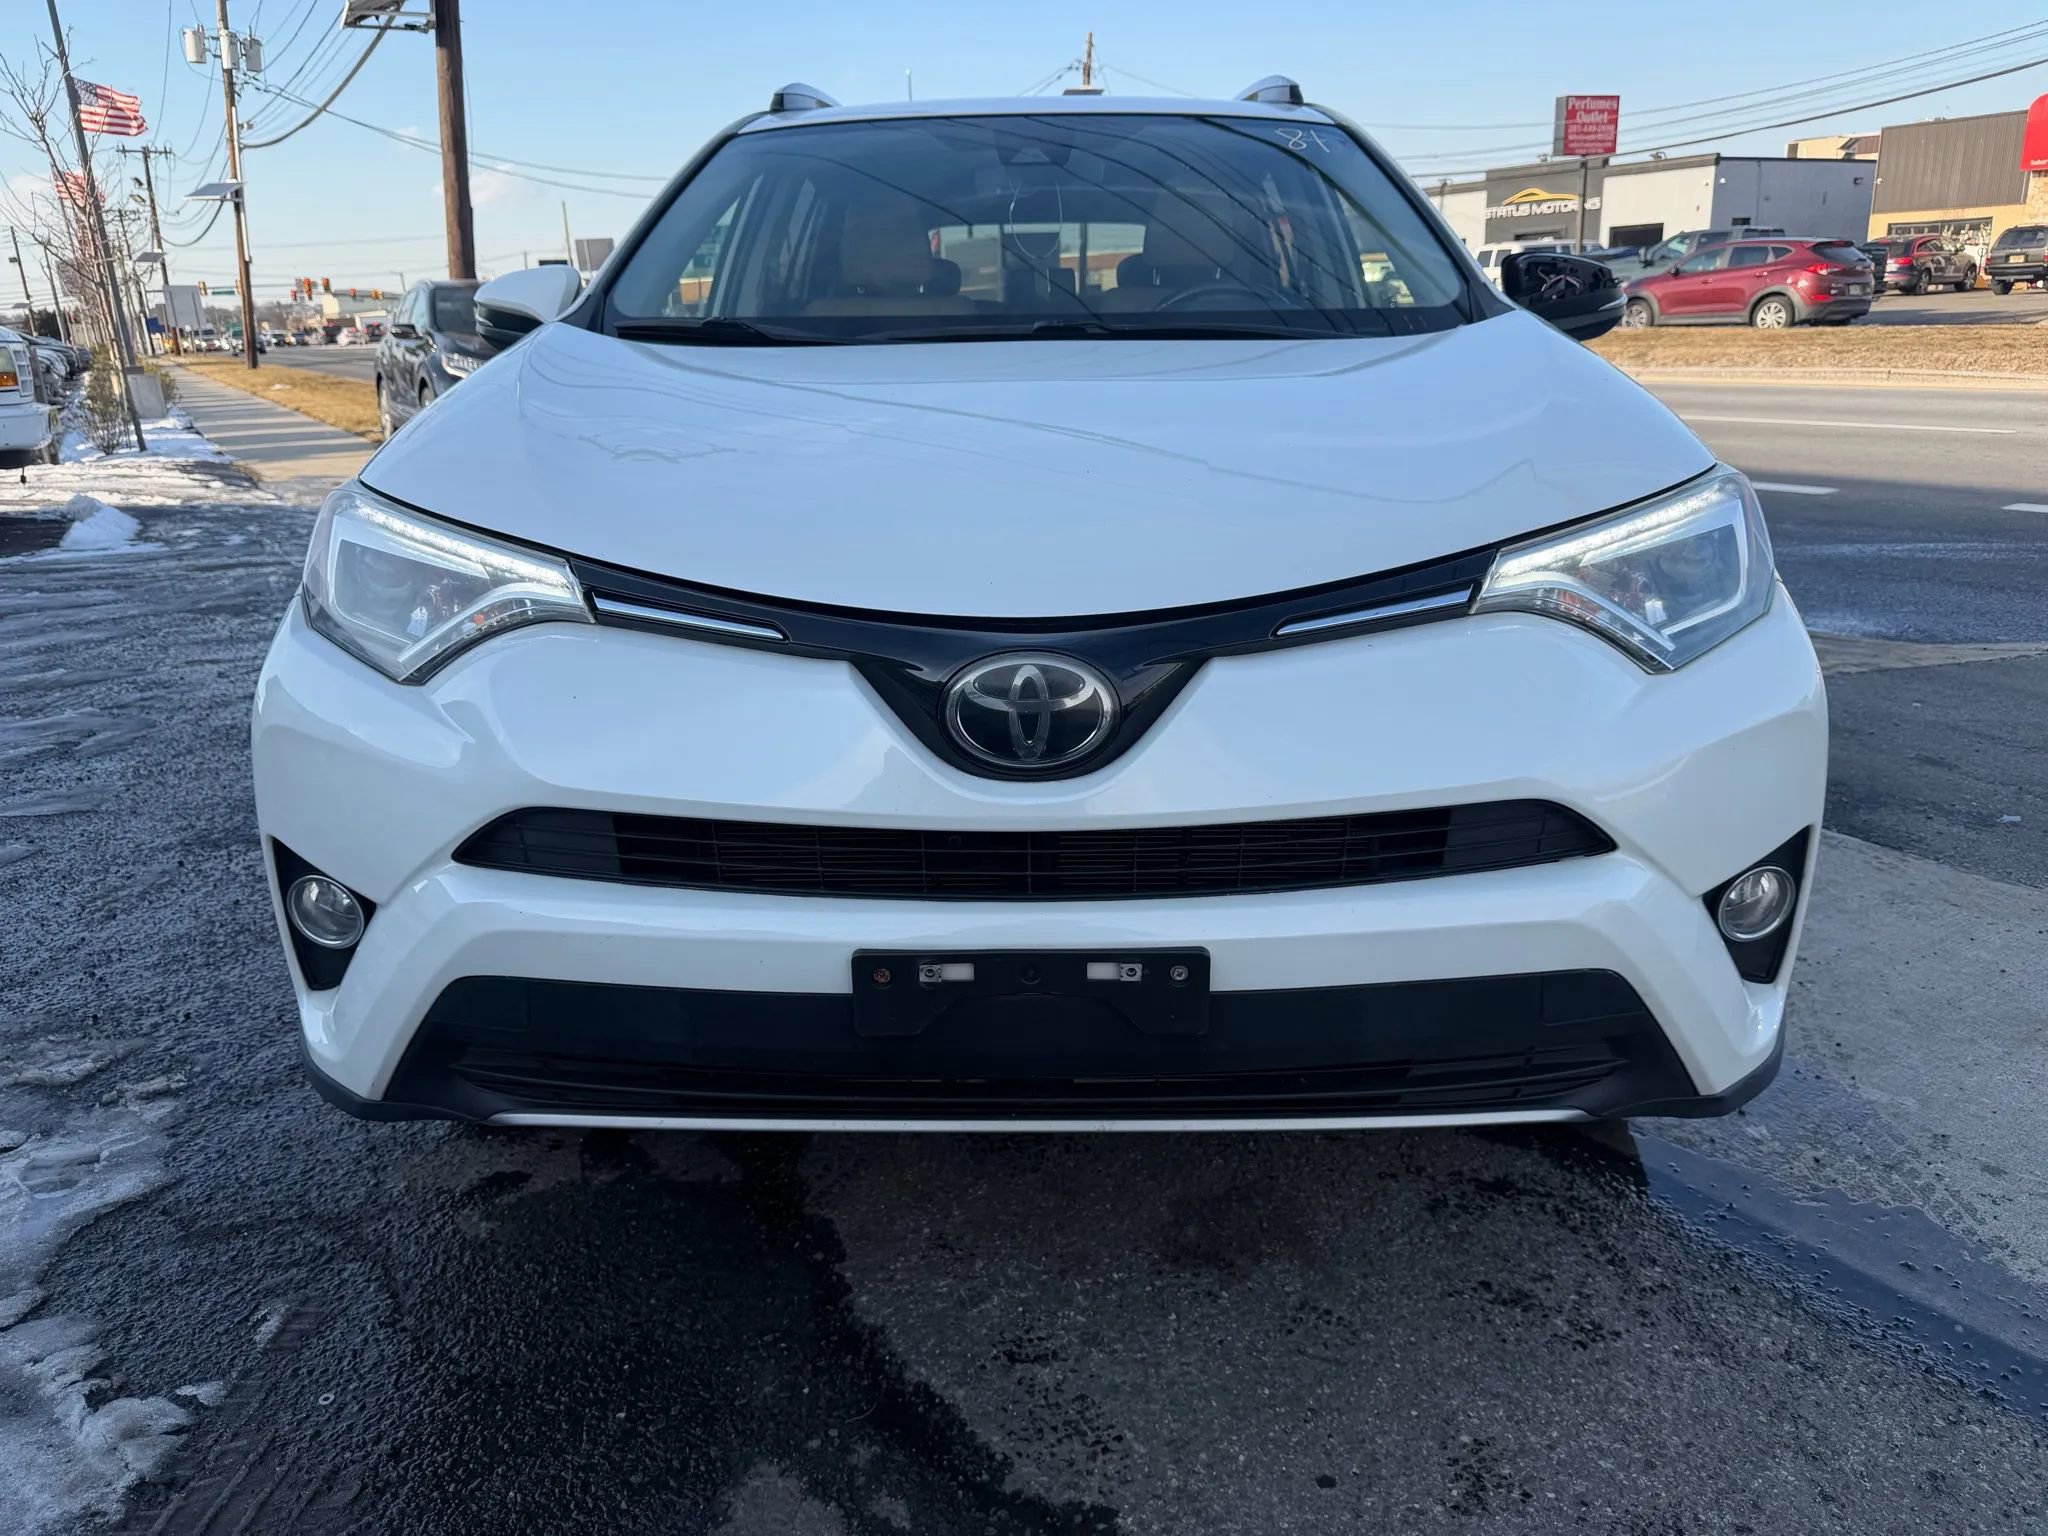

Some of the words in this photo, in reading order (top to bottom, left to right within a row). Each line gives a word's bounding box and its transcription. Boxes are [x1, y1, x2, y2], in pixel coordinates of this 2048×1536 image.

[1568, 97, 1617, 110] Perfumes
[1576, 110, 1608, 123] Outlet
[1484, 203, 1531, 219] STATUS
[1532, 197, 1600, 215] MOTORNG
